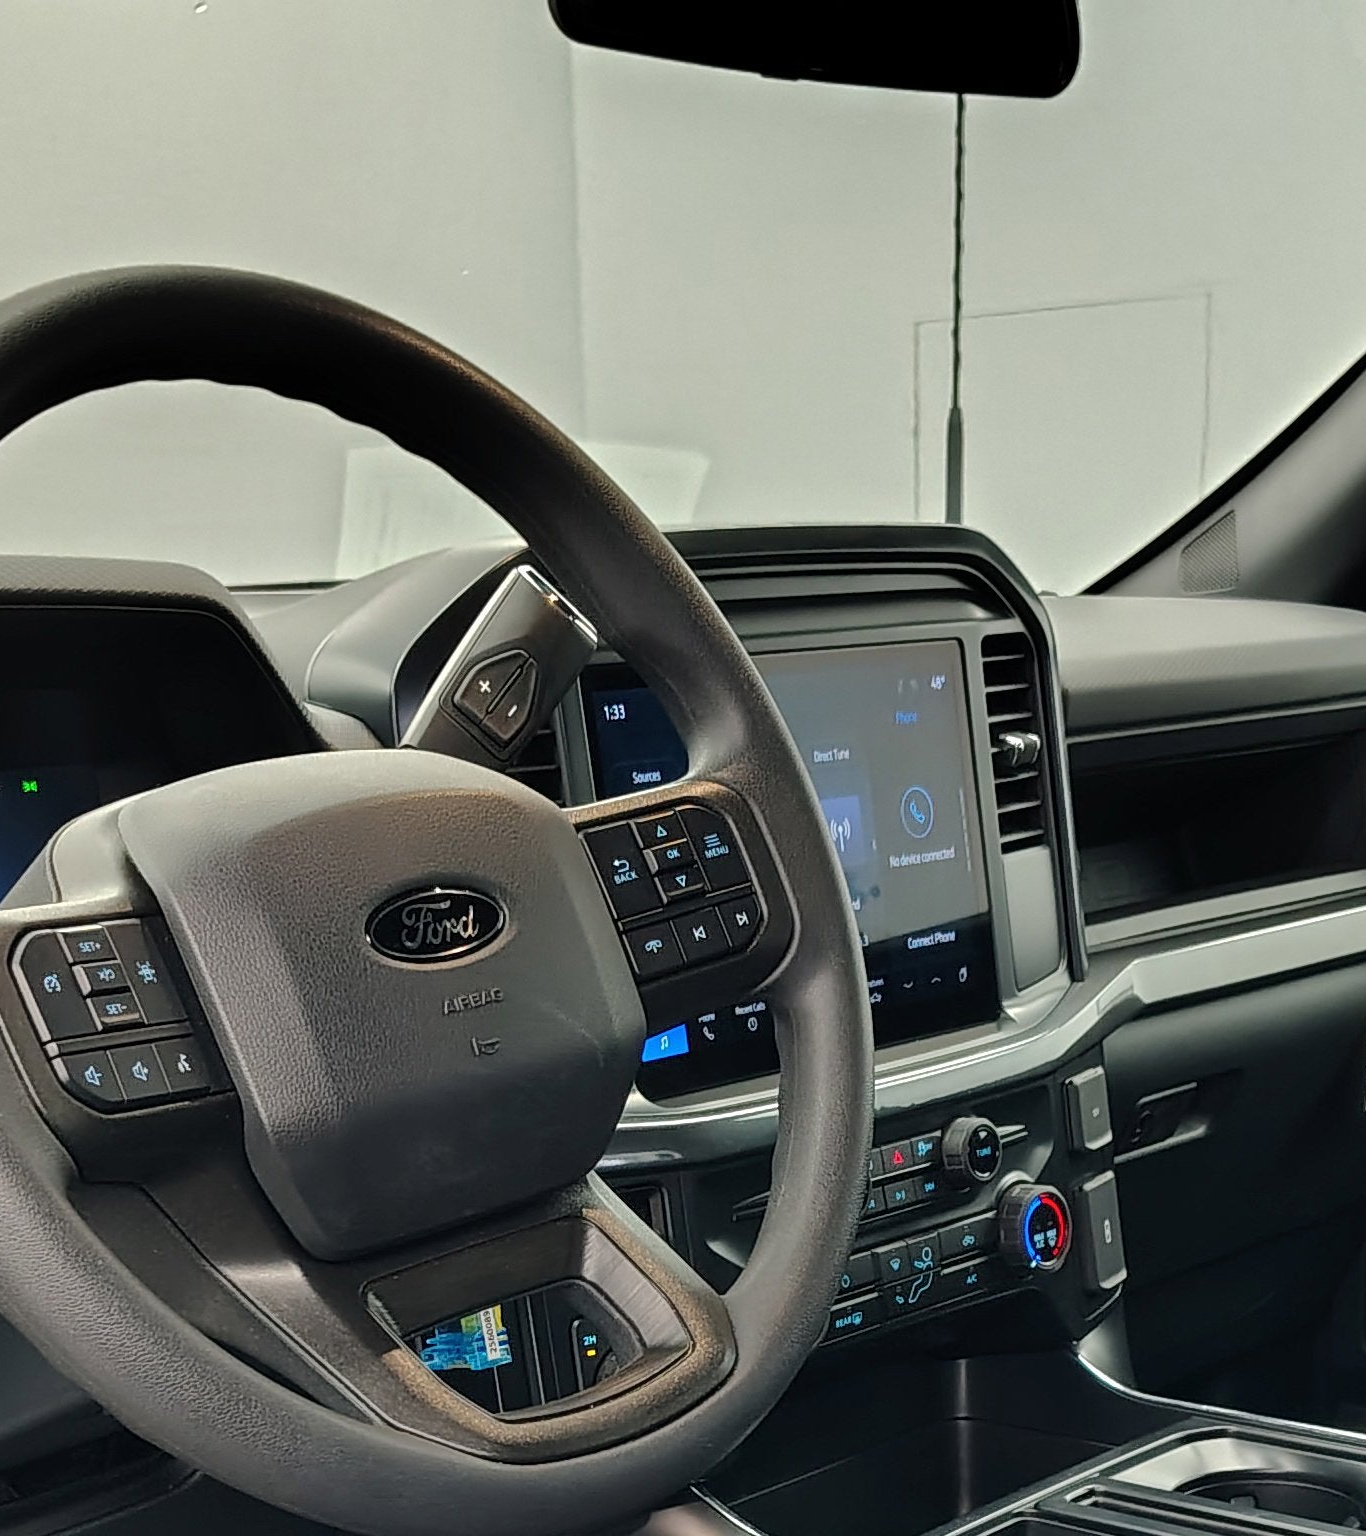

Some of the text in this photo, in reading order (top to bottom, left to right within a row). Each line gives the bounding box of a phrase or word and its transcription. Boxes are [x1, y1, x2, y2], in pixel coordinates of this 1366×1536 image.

[603, 704, 626, 721] 1:33
[813, 748, 850, 763] Direct Tune
[632, 771, 662, 785] Sources
[666, 848, 681, 860] OK
[704, 845, 729, 860] MENU
[890, 846, 956, 869] No device connected
[614, 871, 640, 885] BACK
[401, 899, 480, 950] Ford
[78, 941, 102, 953] SET+
[907, 931, 956, 950] Connect Phone
[443, 986, 504, 1016] AIRBAG
[106, 1003, 127, 1015] SET-
[735, 1002, 766, 1015] Recent Calls
[966, 1273, 978, 1285] A/C
[835, 1315, 852, 1329] REAR
[583, 1334, 596, 1346] 2H
